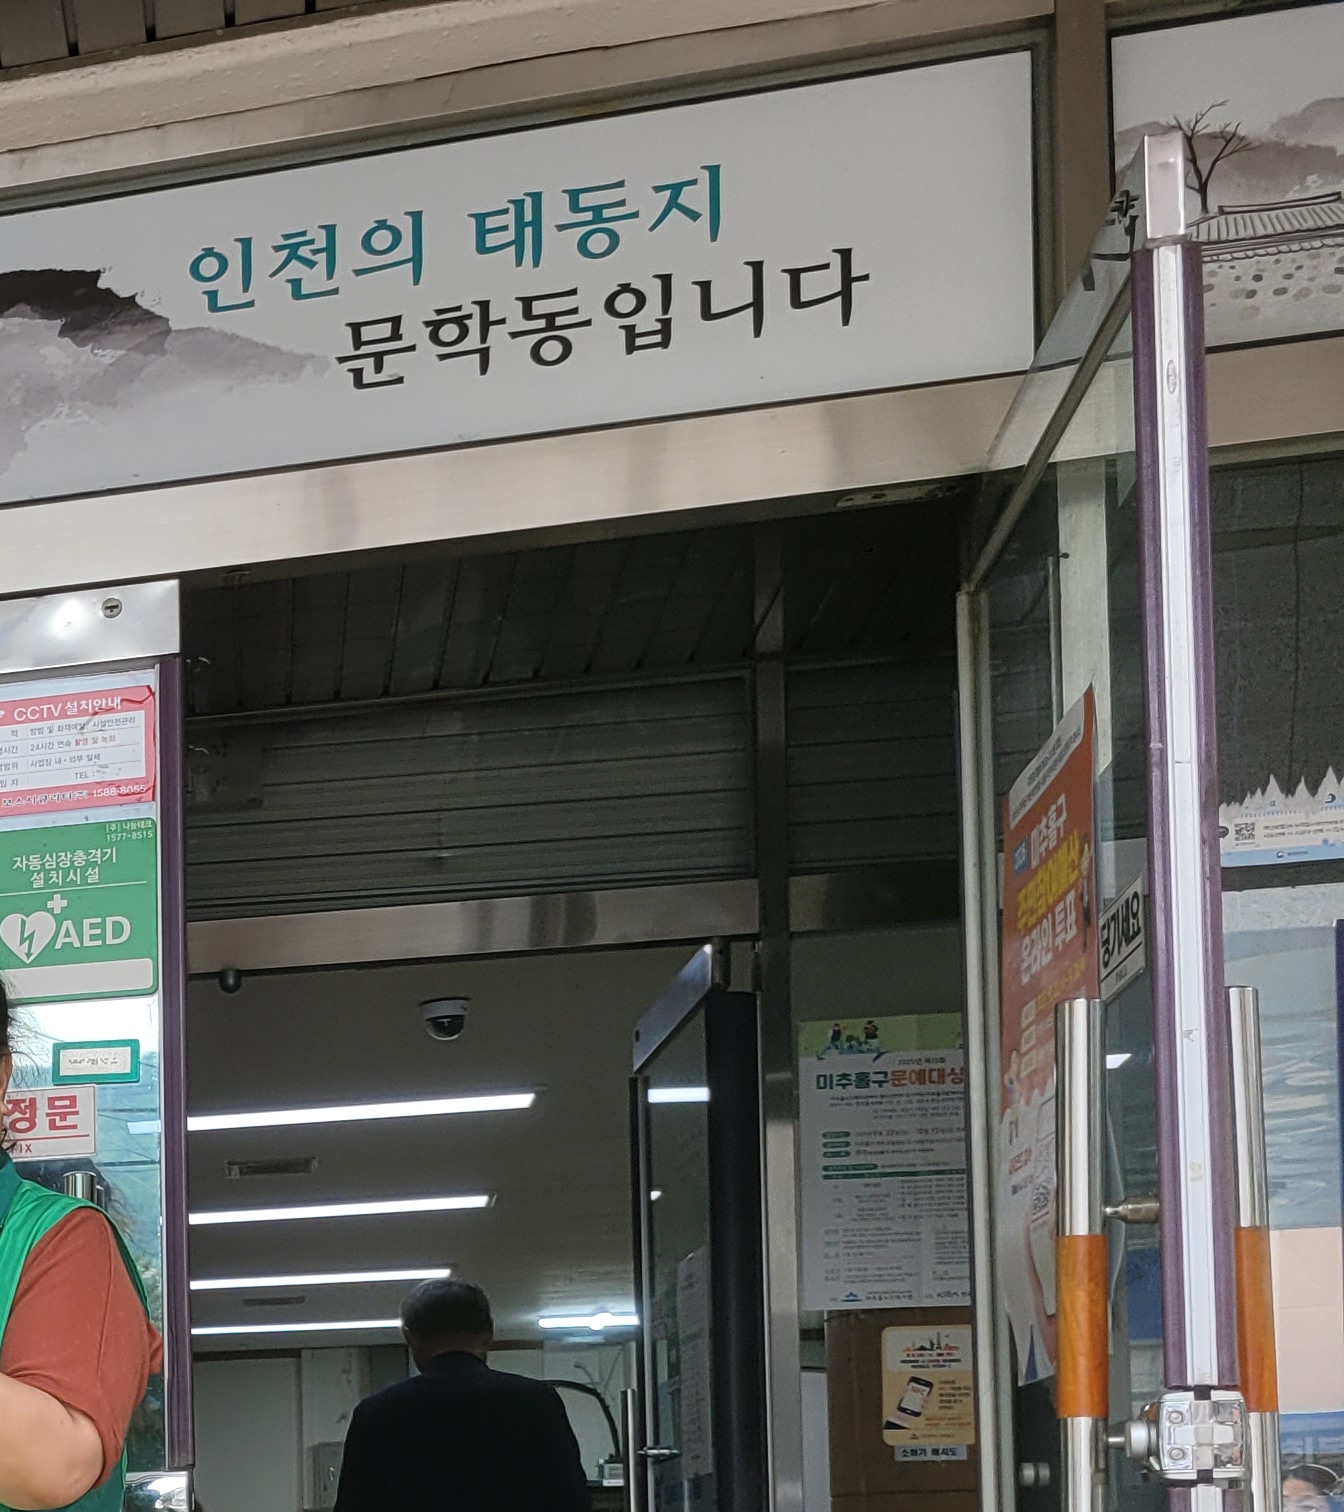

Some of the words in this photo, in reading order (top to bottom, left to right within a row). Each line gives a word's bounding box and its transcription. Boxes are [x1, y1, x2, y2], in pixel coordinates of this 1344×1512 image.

[188, 210, 424, 314] 인천의
[468, 164, 727, 269] 태동지
[335, 248, 870, 391] 문학동입니다
[14, 703, 62, 721] CCTV
[65, 696, 121, 716] 설치안내
[30, 742, 54, 751] 24시간
[92, 785, 147, 798] 1588-8055
[106, 830, 153, 842] 1577-8515
[12, 847, 117, 872] 자동심장충격기
[54, 915, 131, 950] AED
